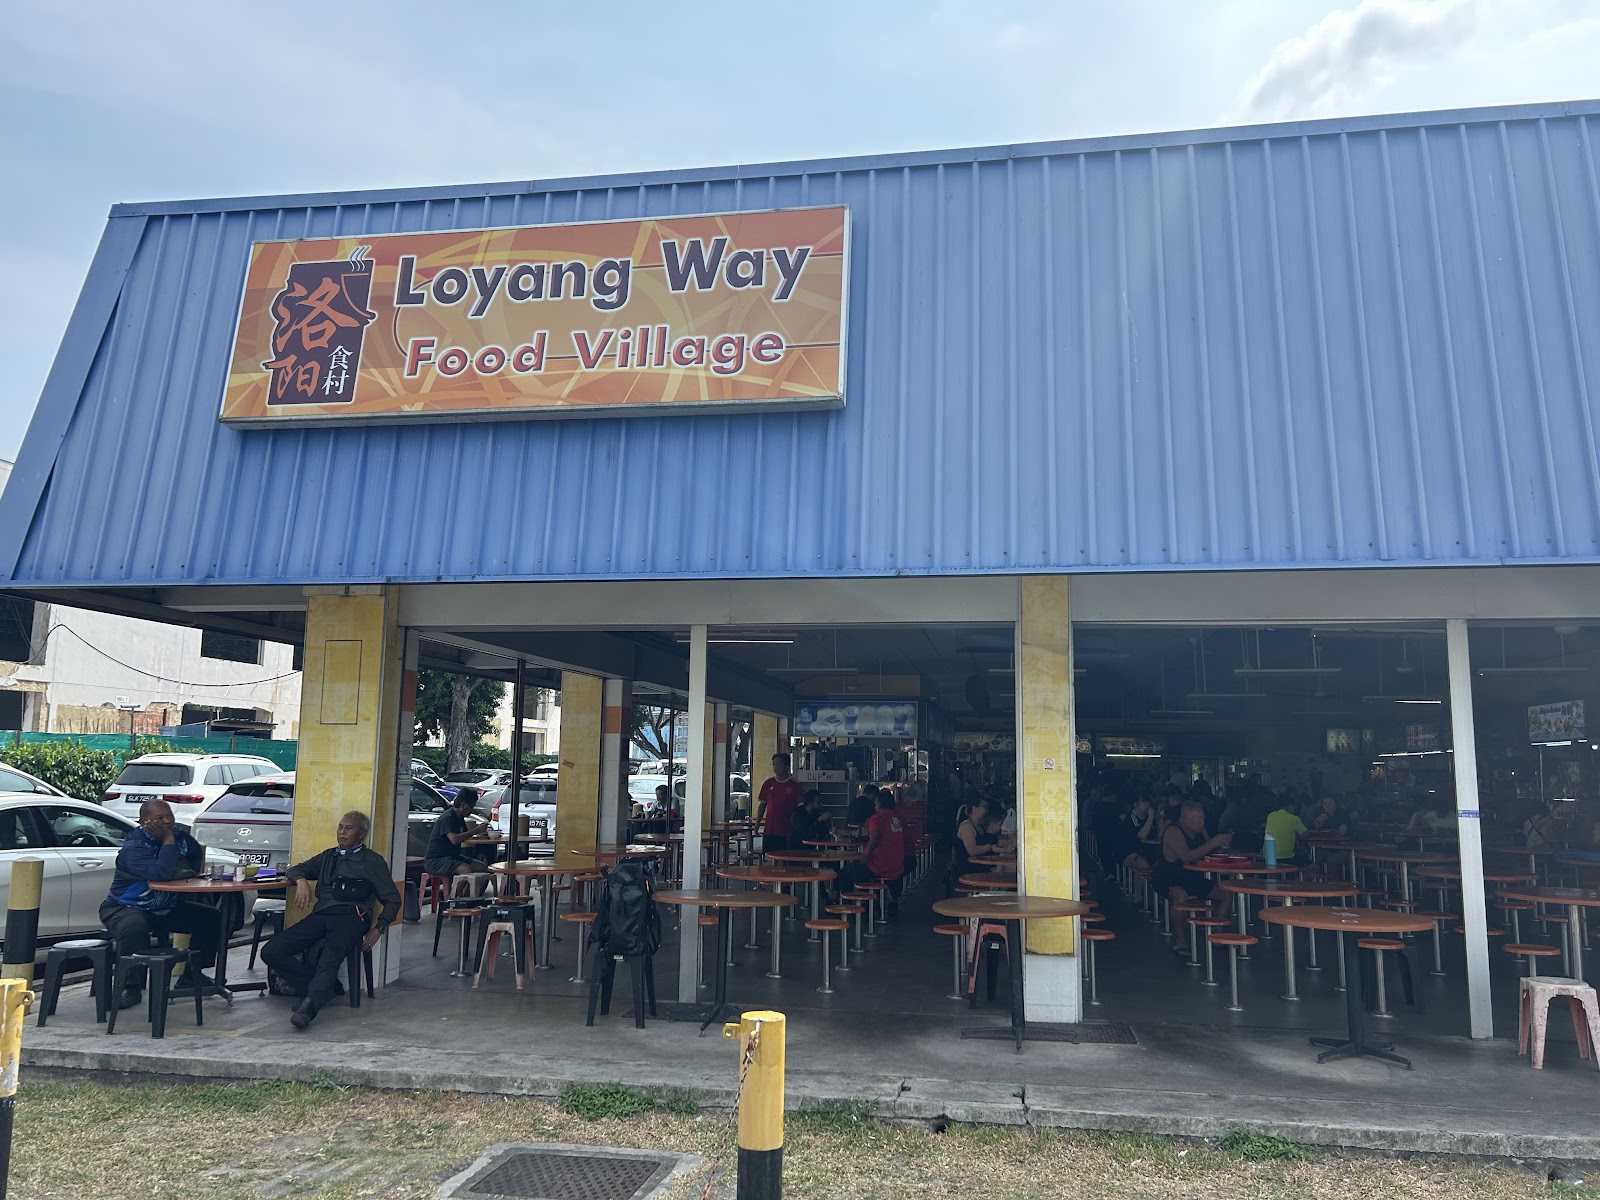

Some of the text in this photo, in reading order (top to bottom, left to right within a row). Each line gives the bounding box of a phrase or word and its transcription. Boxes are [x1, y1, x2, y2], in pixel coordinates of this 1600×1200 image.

[395, 237, 811, 317] Loyang Way
[267, 276, 360, 398] 洛阳
[405, 325, 784, 377] Food Village
[321, 345, 353, 396] 食村
[807, 772, 823, 781] CUP
